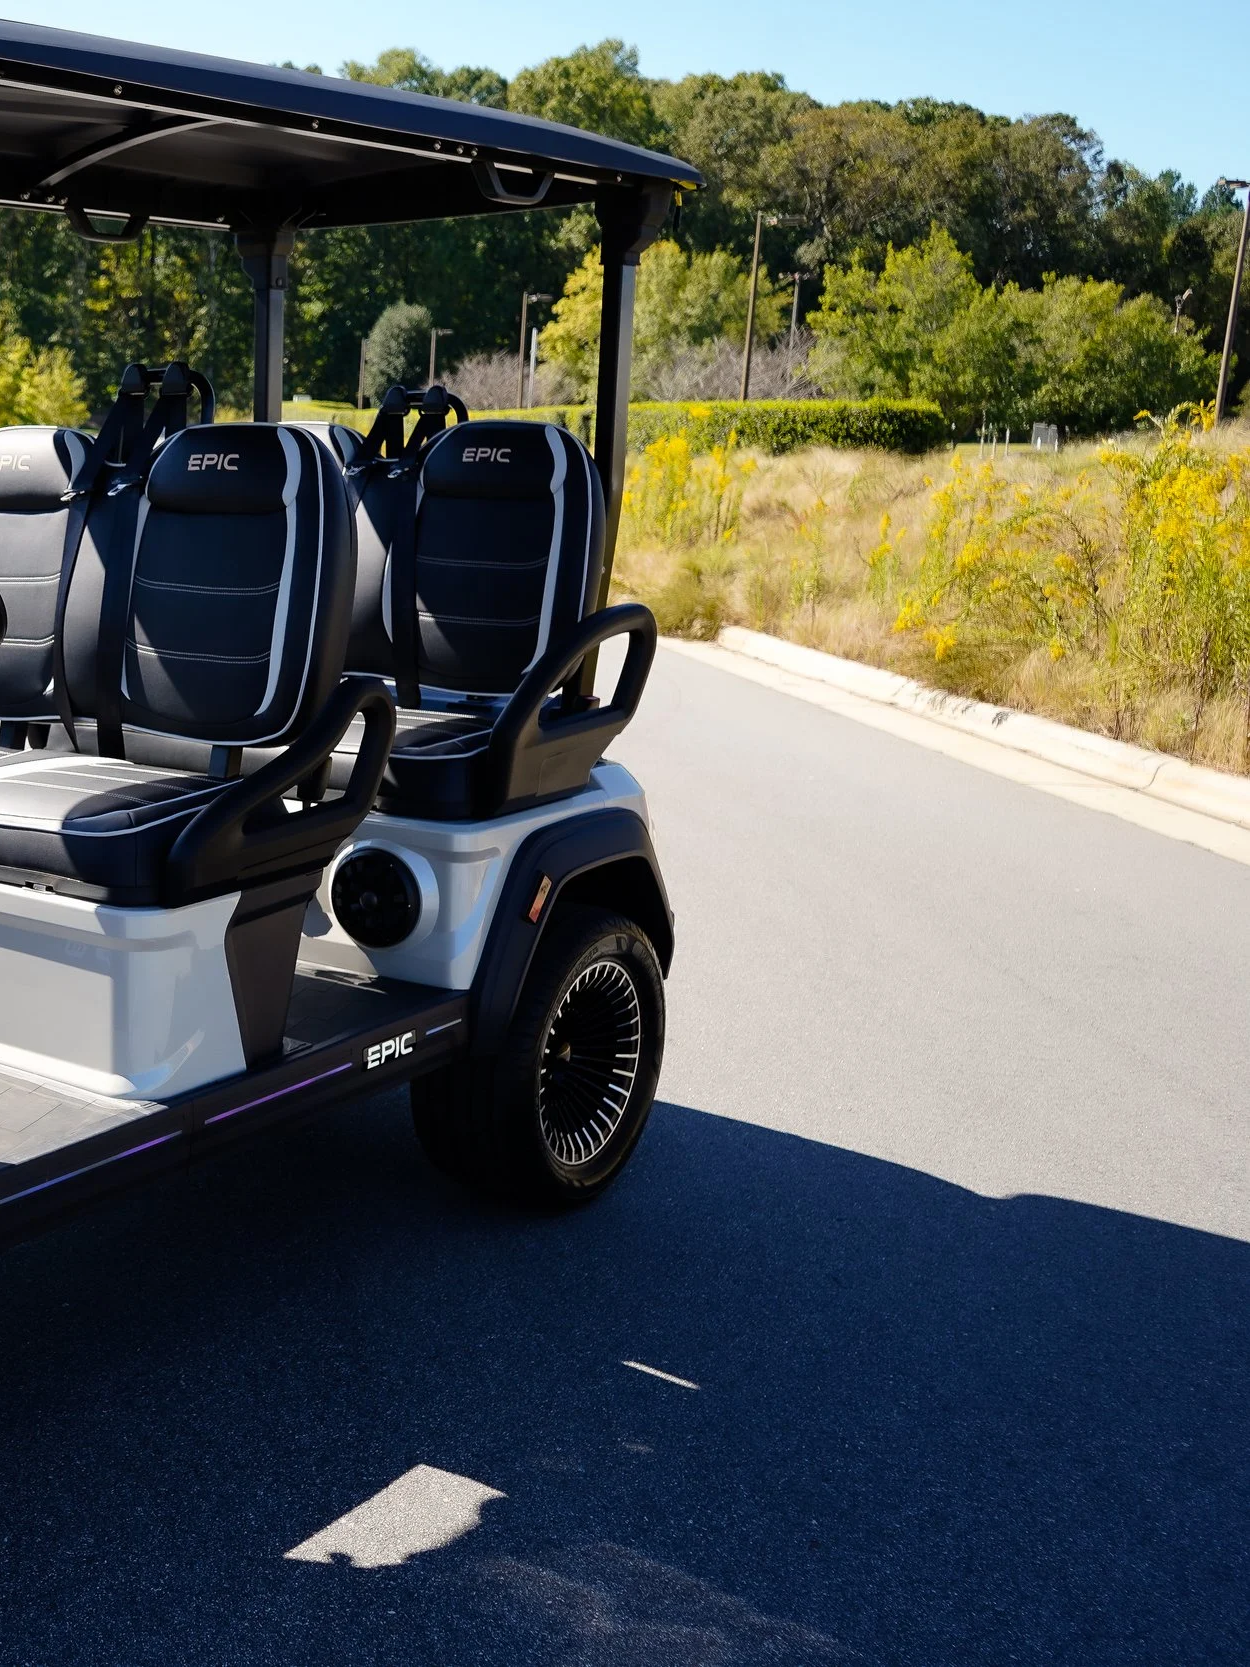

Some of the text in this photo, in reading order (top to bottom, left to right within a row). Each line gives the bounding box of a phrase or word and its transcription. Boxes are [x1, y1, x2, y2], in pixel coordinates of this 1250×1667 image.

[187, 453, 240, 471] EPIC
[462, 447, 512, 463] EPIC
[366, 1031, 414, 1070] EPIC
